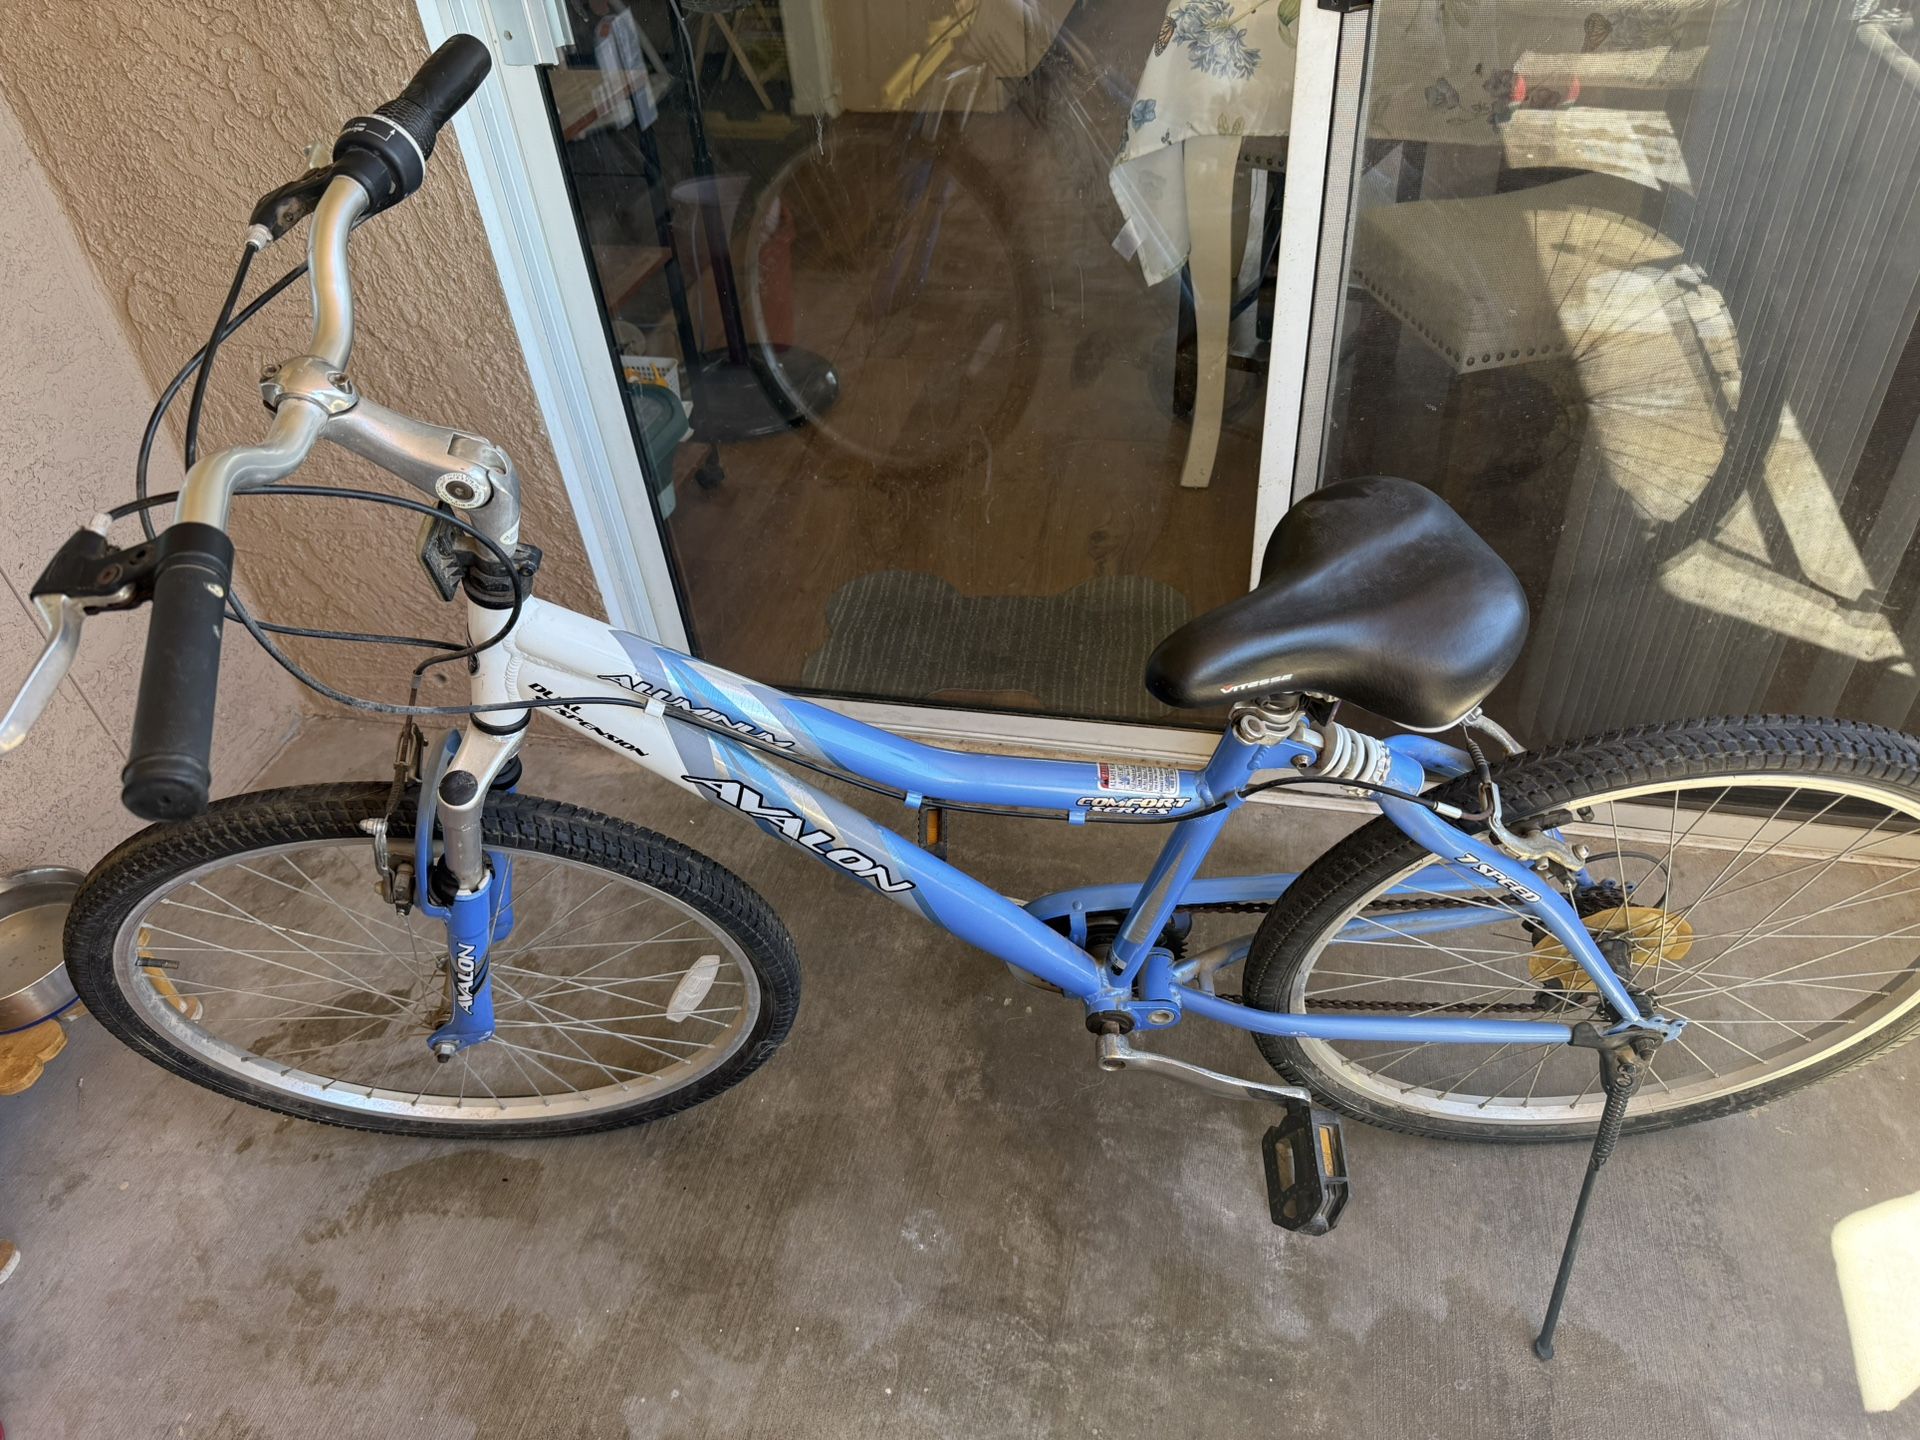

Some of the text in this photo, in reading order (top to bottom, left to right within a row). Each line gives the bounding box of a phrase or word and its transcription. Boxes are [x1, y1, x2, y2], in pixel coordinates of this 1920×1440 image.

[532, 695, 649, 757] SPENSION
[597, 674, 796, 749] ALUMINUM
[1076, 796, 1191, 809] COMFORT
[1087, 806, 1173, 816] SERIES
[680, 775, 916, 893] AVALON
[1454, 852, 1542, 903] 7 SPEED
[457, 941, 476, 1016] AVALON
